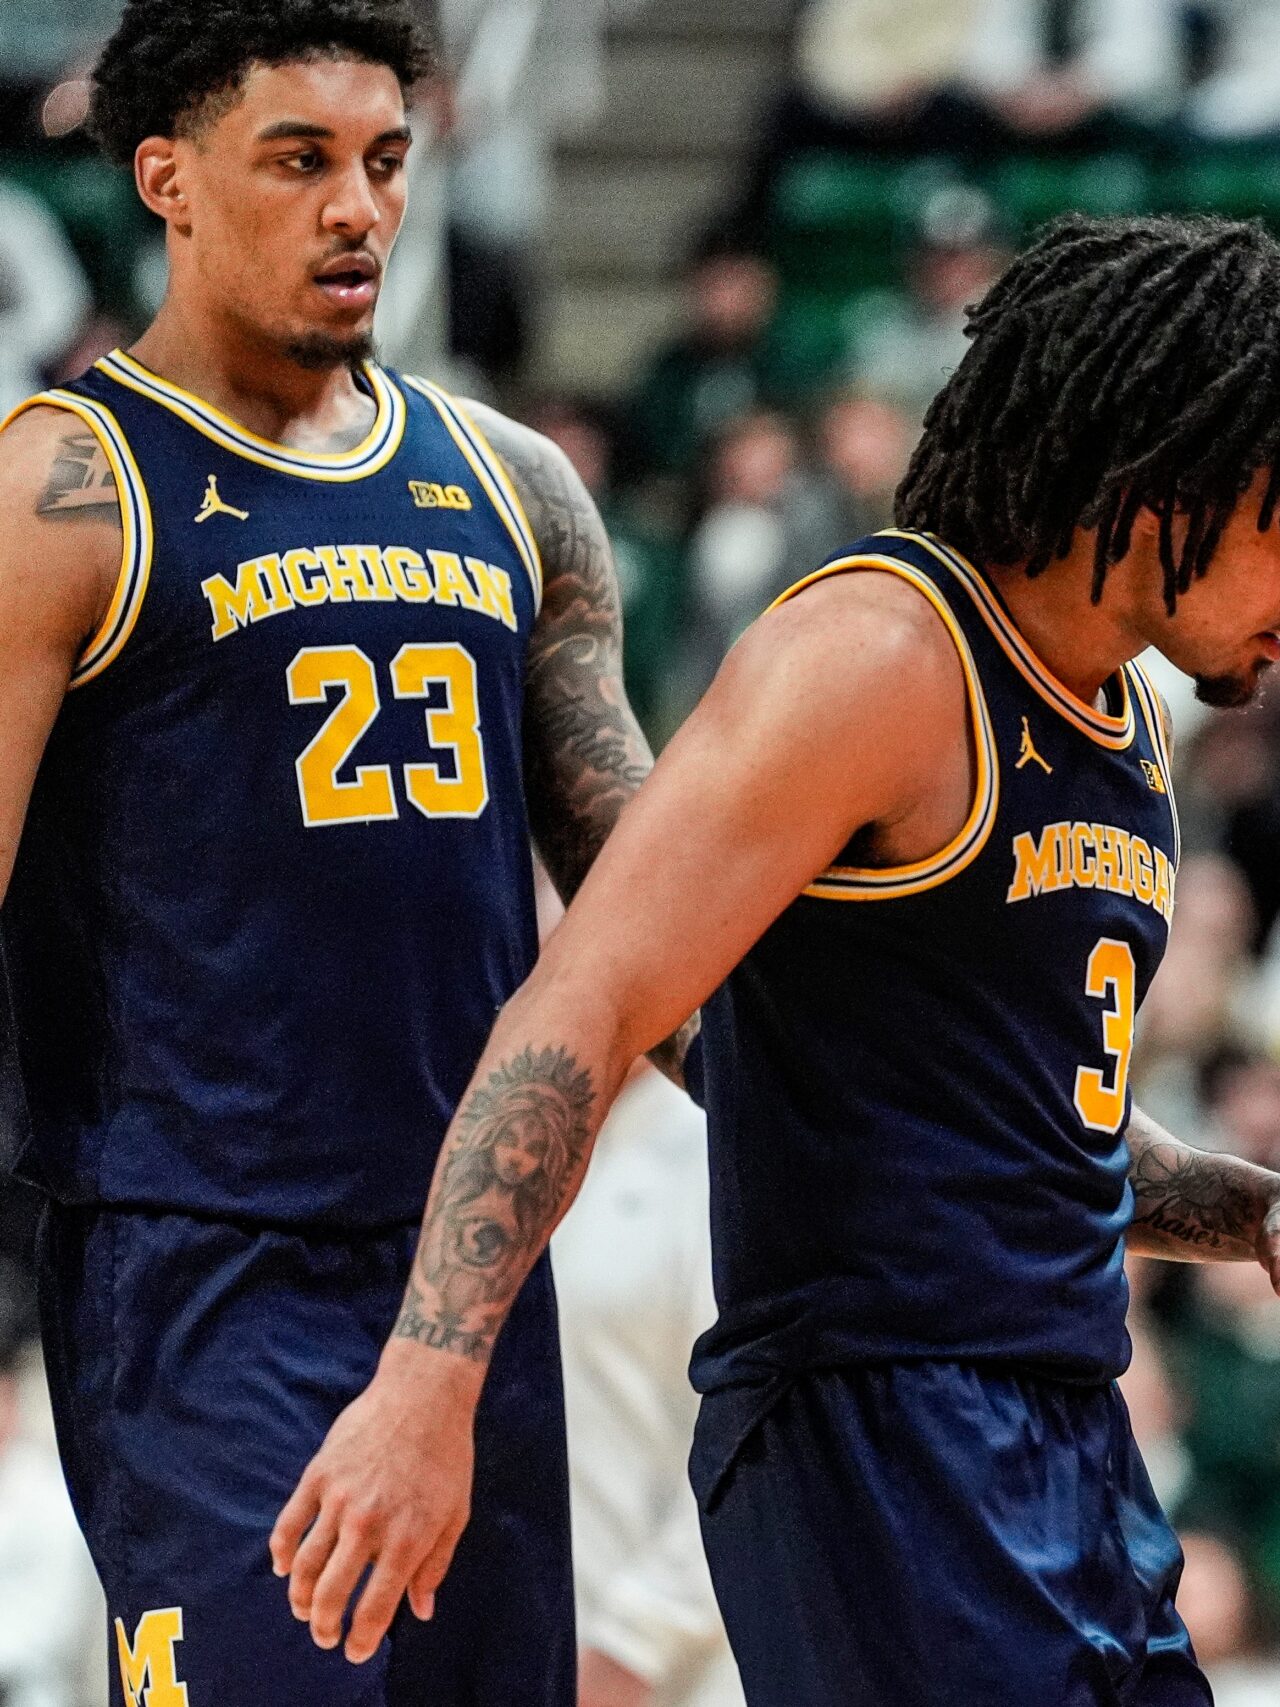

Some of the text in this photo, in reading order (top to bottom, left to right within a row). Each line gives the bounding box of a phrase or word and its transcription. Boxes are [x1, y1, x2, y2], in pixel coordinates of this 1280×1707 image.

[201, 545, 518, 642] MICHIGAN
[286, 642, 489, 827] 23
[1006, 821, 1175, 926] MICHIGA
[1073, 937, 1136, 1135] 3
[1131, 1193, 1223, 1248] haser
[114, 1606, 190, 1707] M
